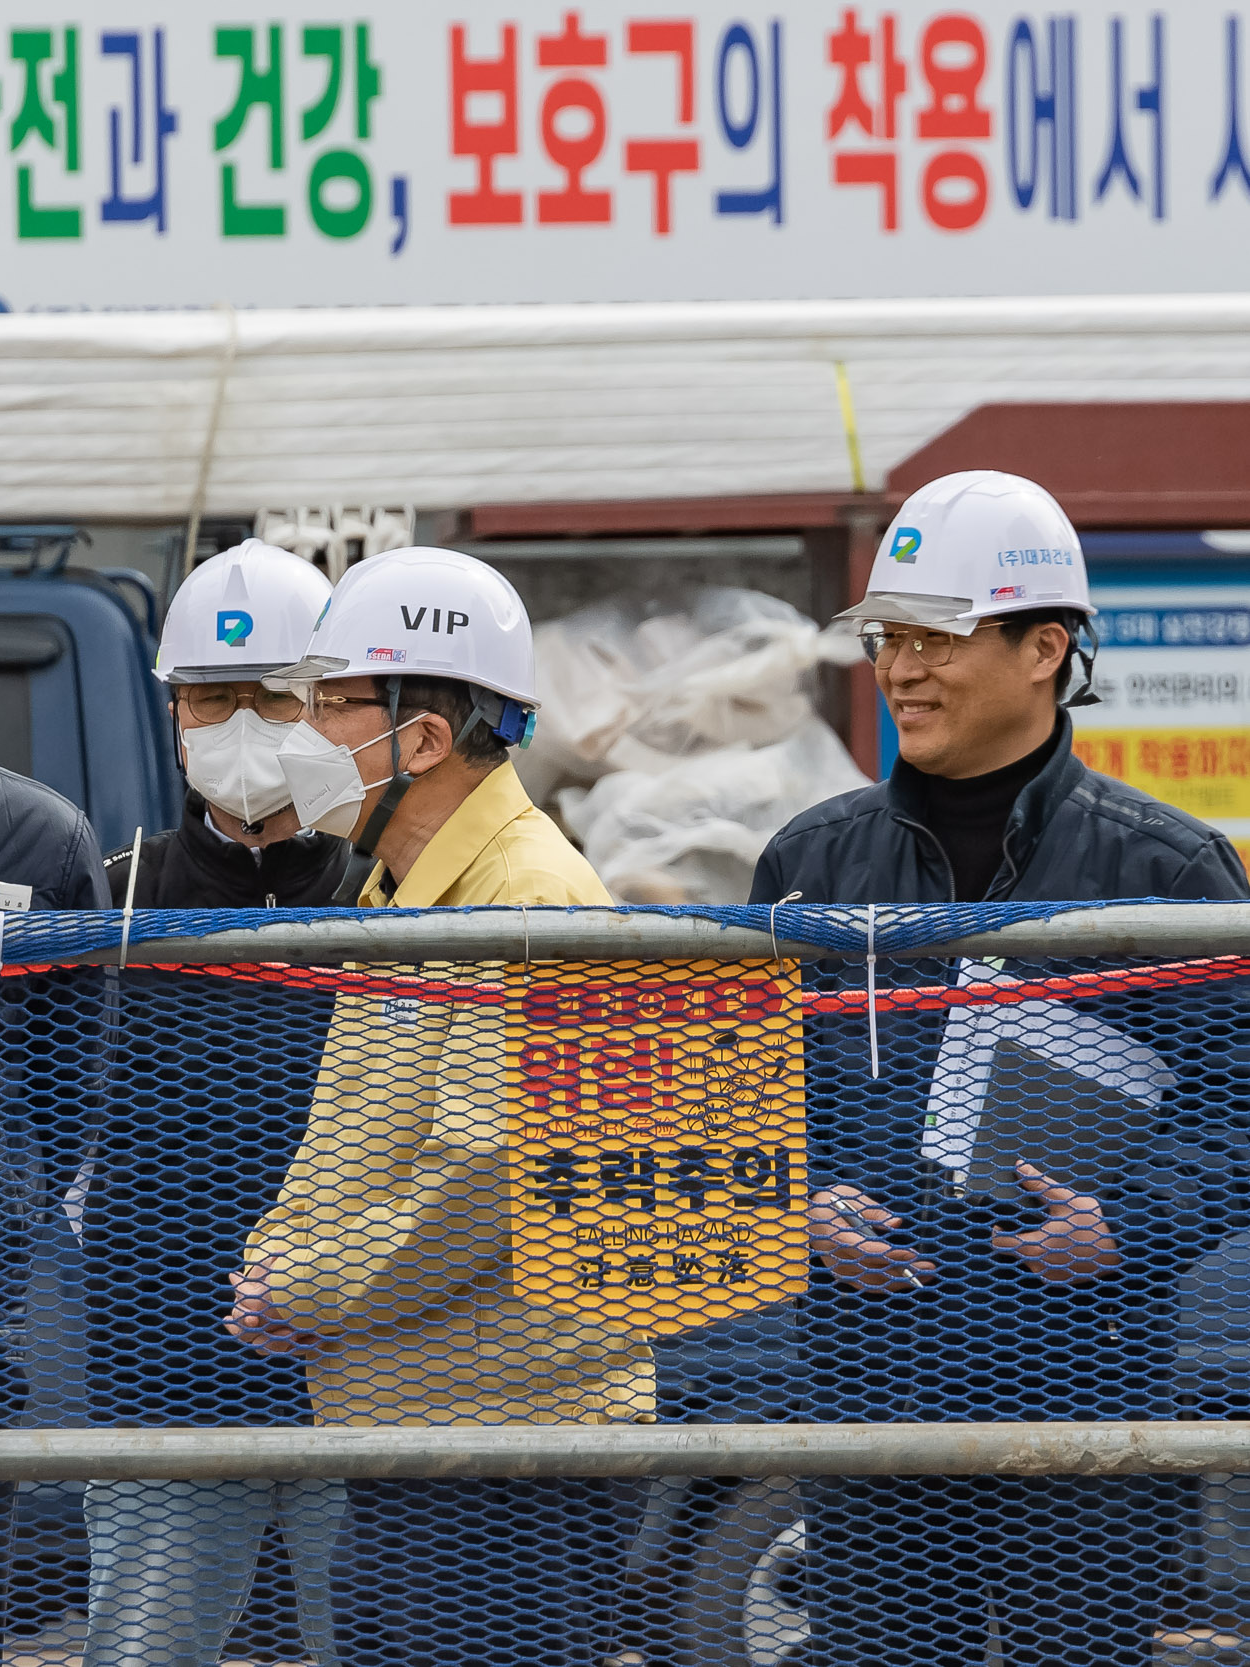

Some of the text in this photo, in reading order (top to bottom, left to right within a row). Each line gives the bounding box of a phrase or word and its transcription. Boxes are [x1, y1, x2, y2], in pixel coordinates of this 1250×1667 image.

[214, 23, 409, 256] 건강,
[449, 14, 780, 235] 보호구의
[829, 11, 1160, 231] 착용에서
[400, 605, 470, 635] VIP
[519, 1038, 675, 1114] 위험!
[576, 1221, 751, 1246] FALLING HAZARD
